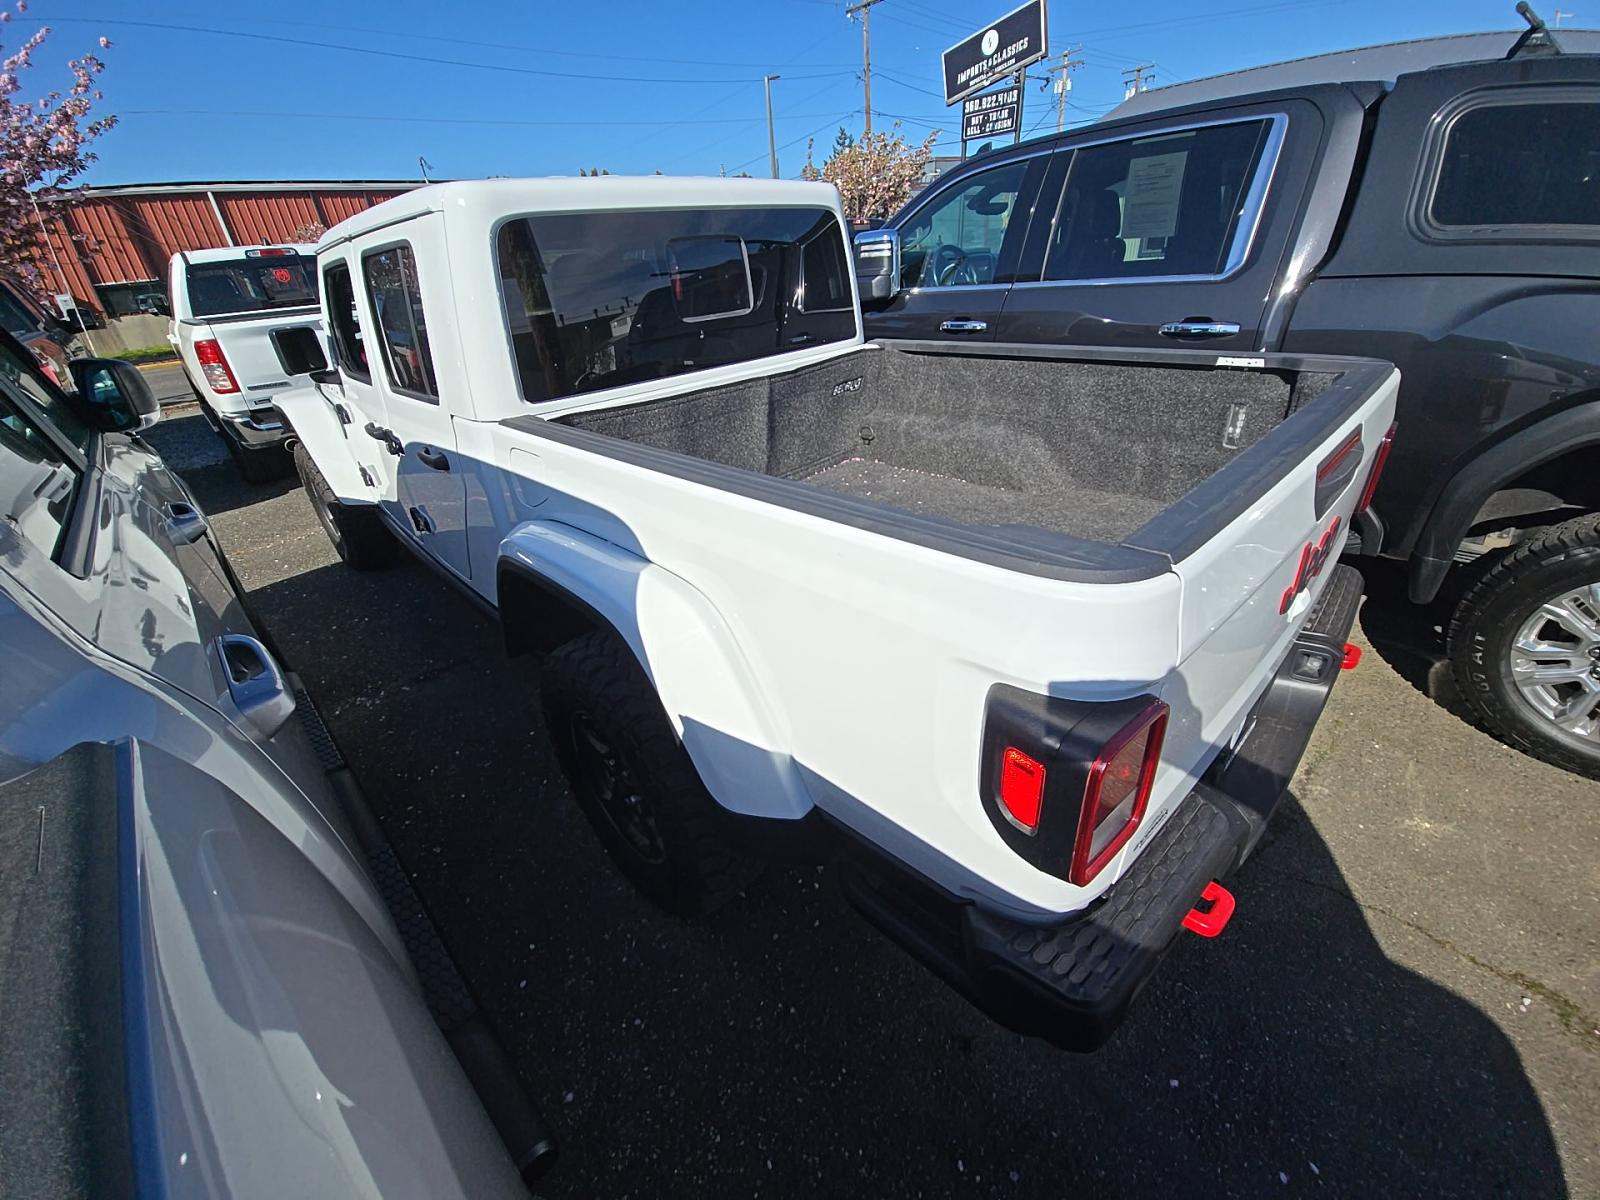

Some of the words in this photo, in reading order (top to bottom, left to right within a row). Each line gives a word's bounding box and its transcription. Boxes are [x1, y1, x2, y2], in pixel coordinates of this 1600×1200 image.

[957, 60, 987, 85] IMPORTS
[993, 37, 1029, 65] CLASSICS
[967, 126, 981, 136] SELL
